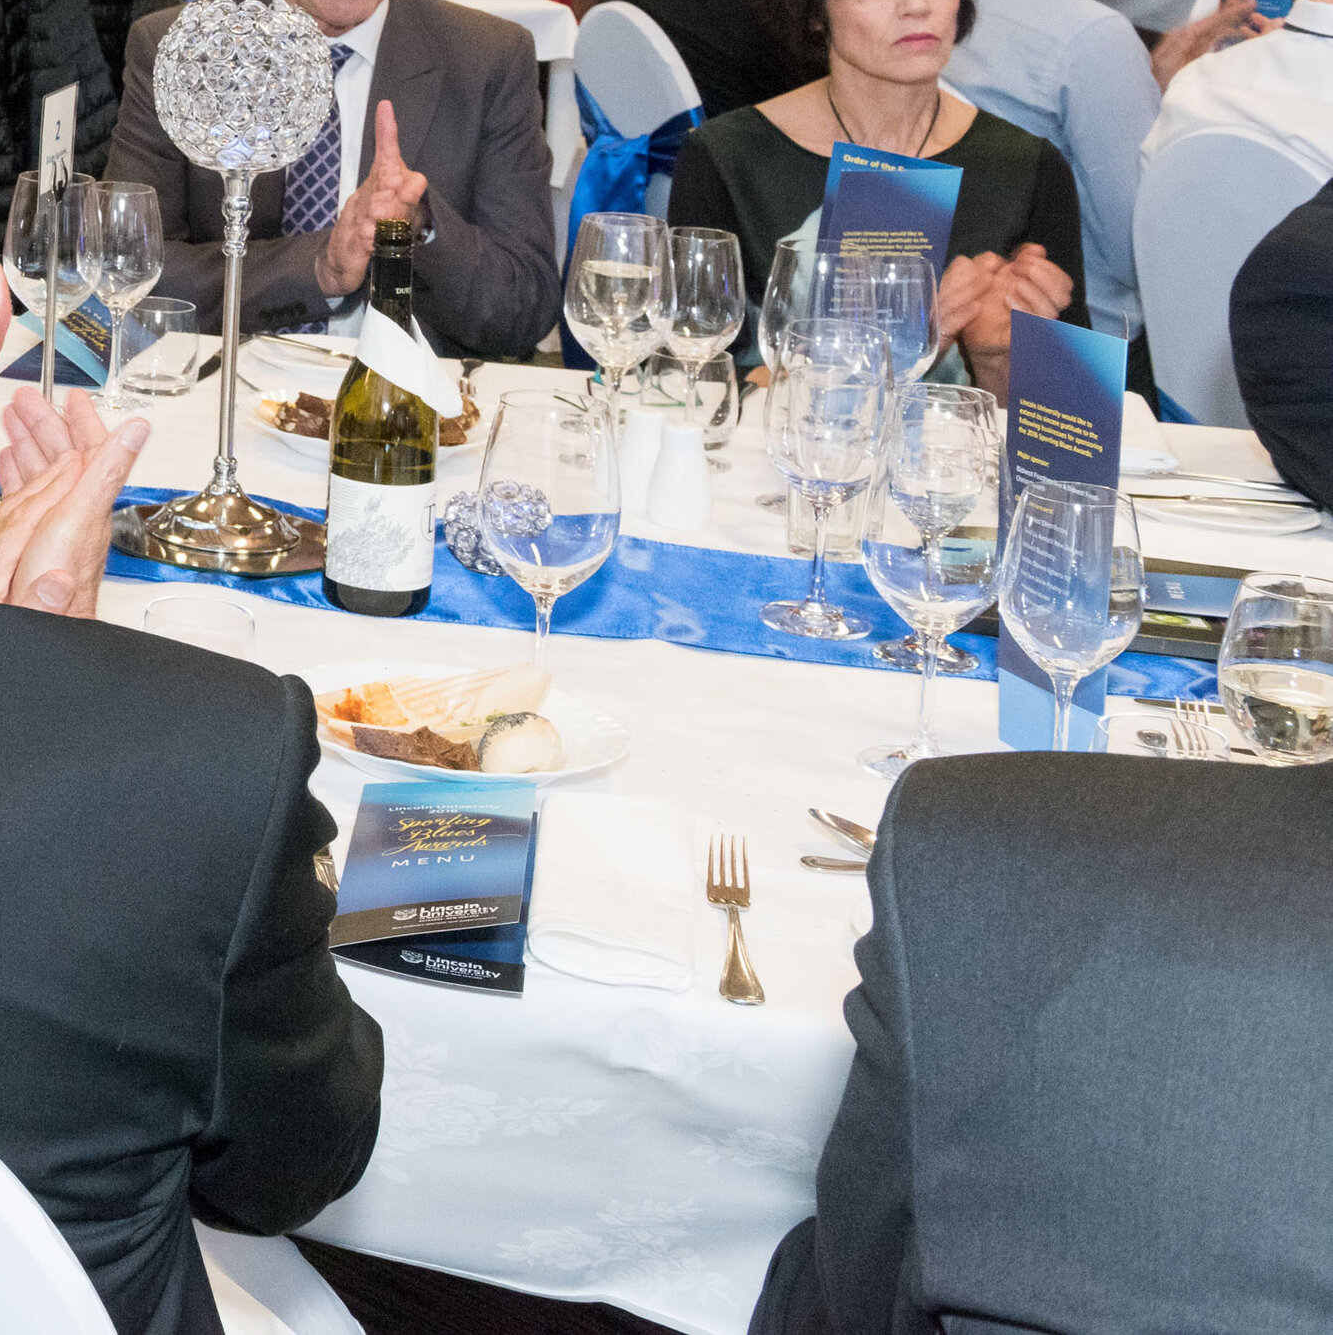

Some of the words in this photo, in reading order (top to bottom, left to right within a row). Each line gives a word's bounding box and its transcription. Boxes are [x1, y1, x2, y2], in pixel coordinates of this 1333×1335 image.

[843, 154, 869, 166] Order
[1020, 398, 1036, 409] Lincoln
[1036, 404, 1061, 418] University
[1061, 413, 1077, 423] would
[1077, 417, 1087, 426] like
[388, 804, 433, 814] Lincoln
[390, 814, 493, 832] Sporting
[398, 825, 476, 842] Blues
[381, 834, 489, 856] Awards
[391, 854, 475, 868] MENU
[419, 907, 499, 918] University
[420, 903, 480, 915] Lincoln
[425, 961, 501, 979] University
[426, 955, 483, 970] Lincoln
